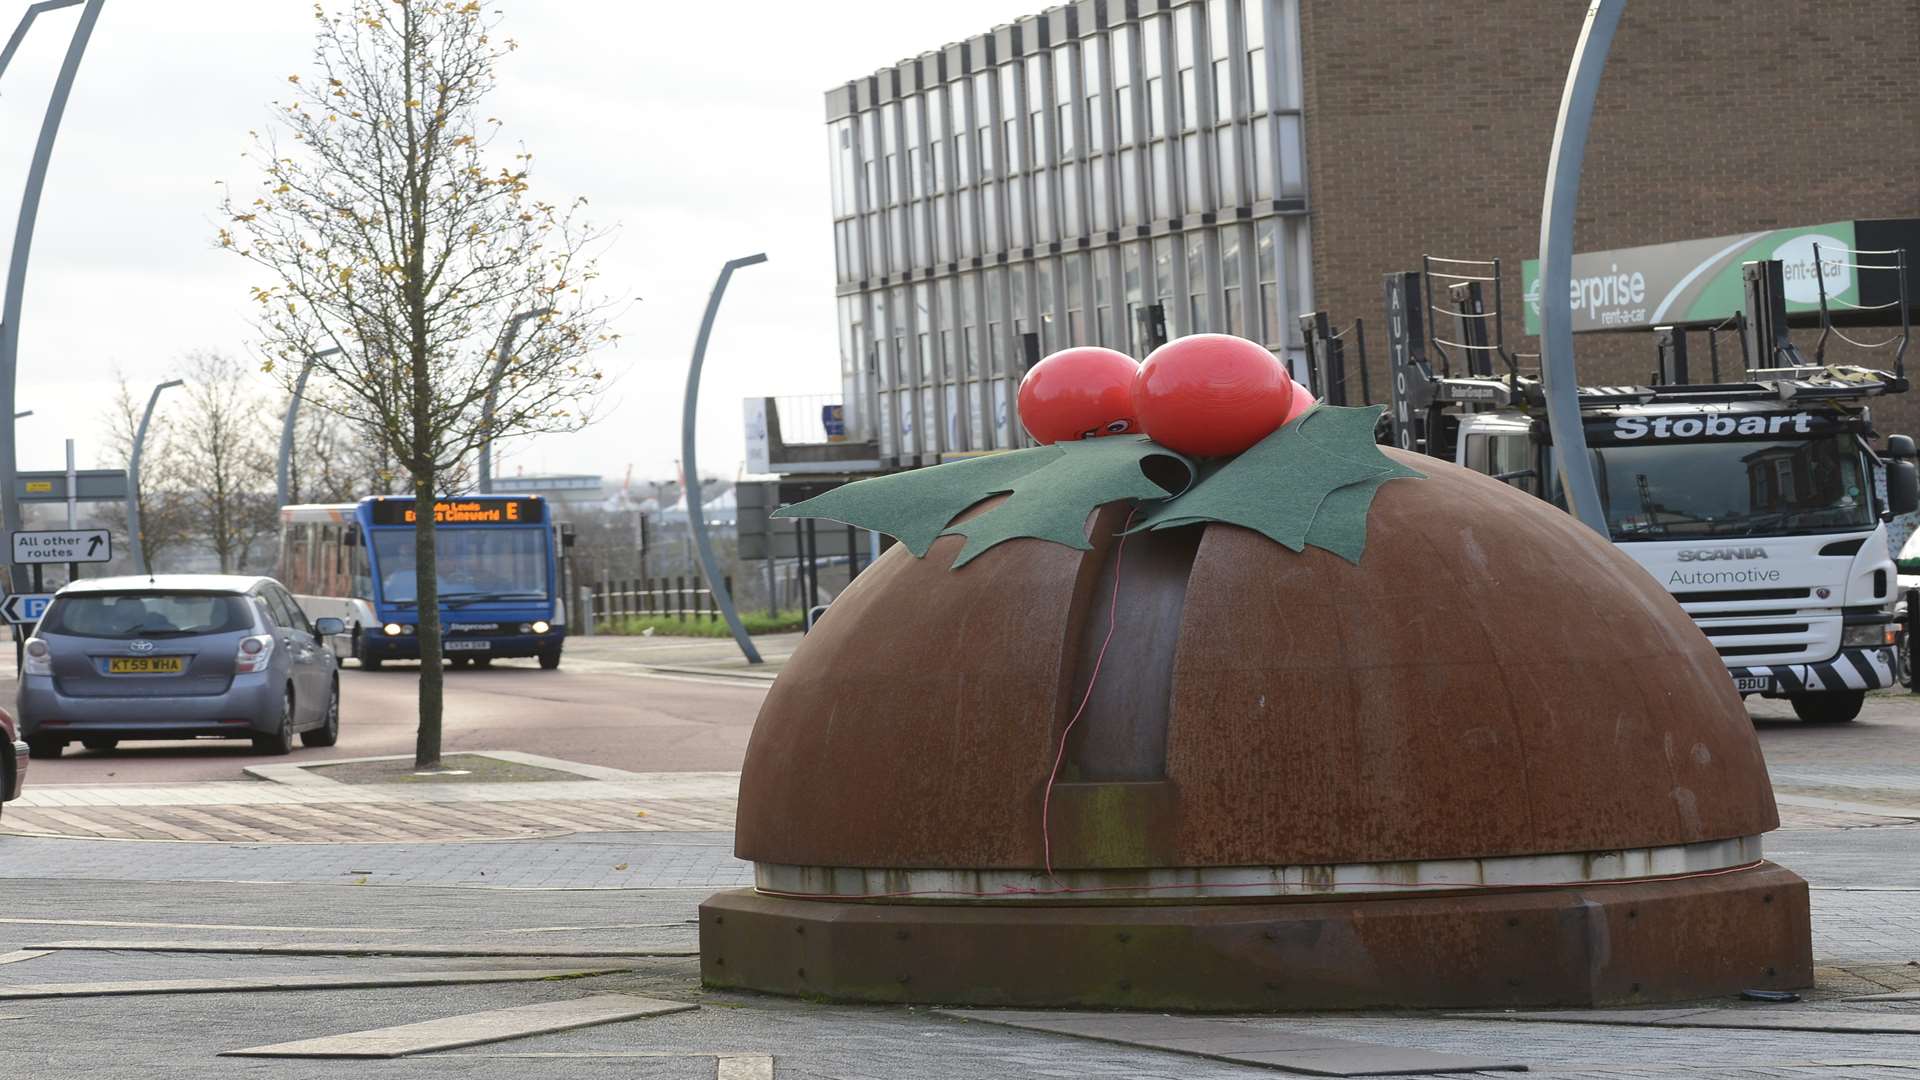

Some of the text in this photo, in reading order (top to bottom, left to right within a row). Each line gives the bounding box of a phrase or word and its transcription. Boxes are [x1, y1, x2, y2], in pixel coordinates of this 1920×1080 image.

[1524, 264, 1645, 319] erprise
[1601, 309, 1647, 325] rent-a-car
[1392, 288, 1409, 449] AUTOMO
[1614, 411, 1813, 439] Stobart
[445, 510, 499, 521] Cineworld
[506, 502, 517, 519] E
[19, 535, 80, 546] All other
[28, 548, 73, 557] routes
[1677, 547, 1768, 562] SCANIA
[1669, 567, 1780, 584] Automotive
[112, 659, 179, 670] KT59 WHA
[1739, 678, 1766, 689] BDU
